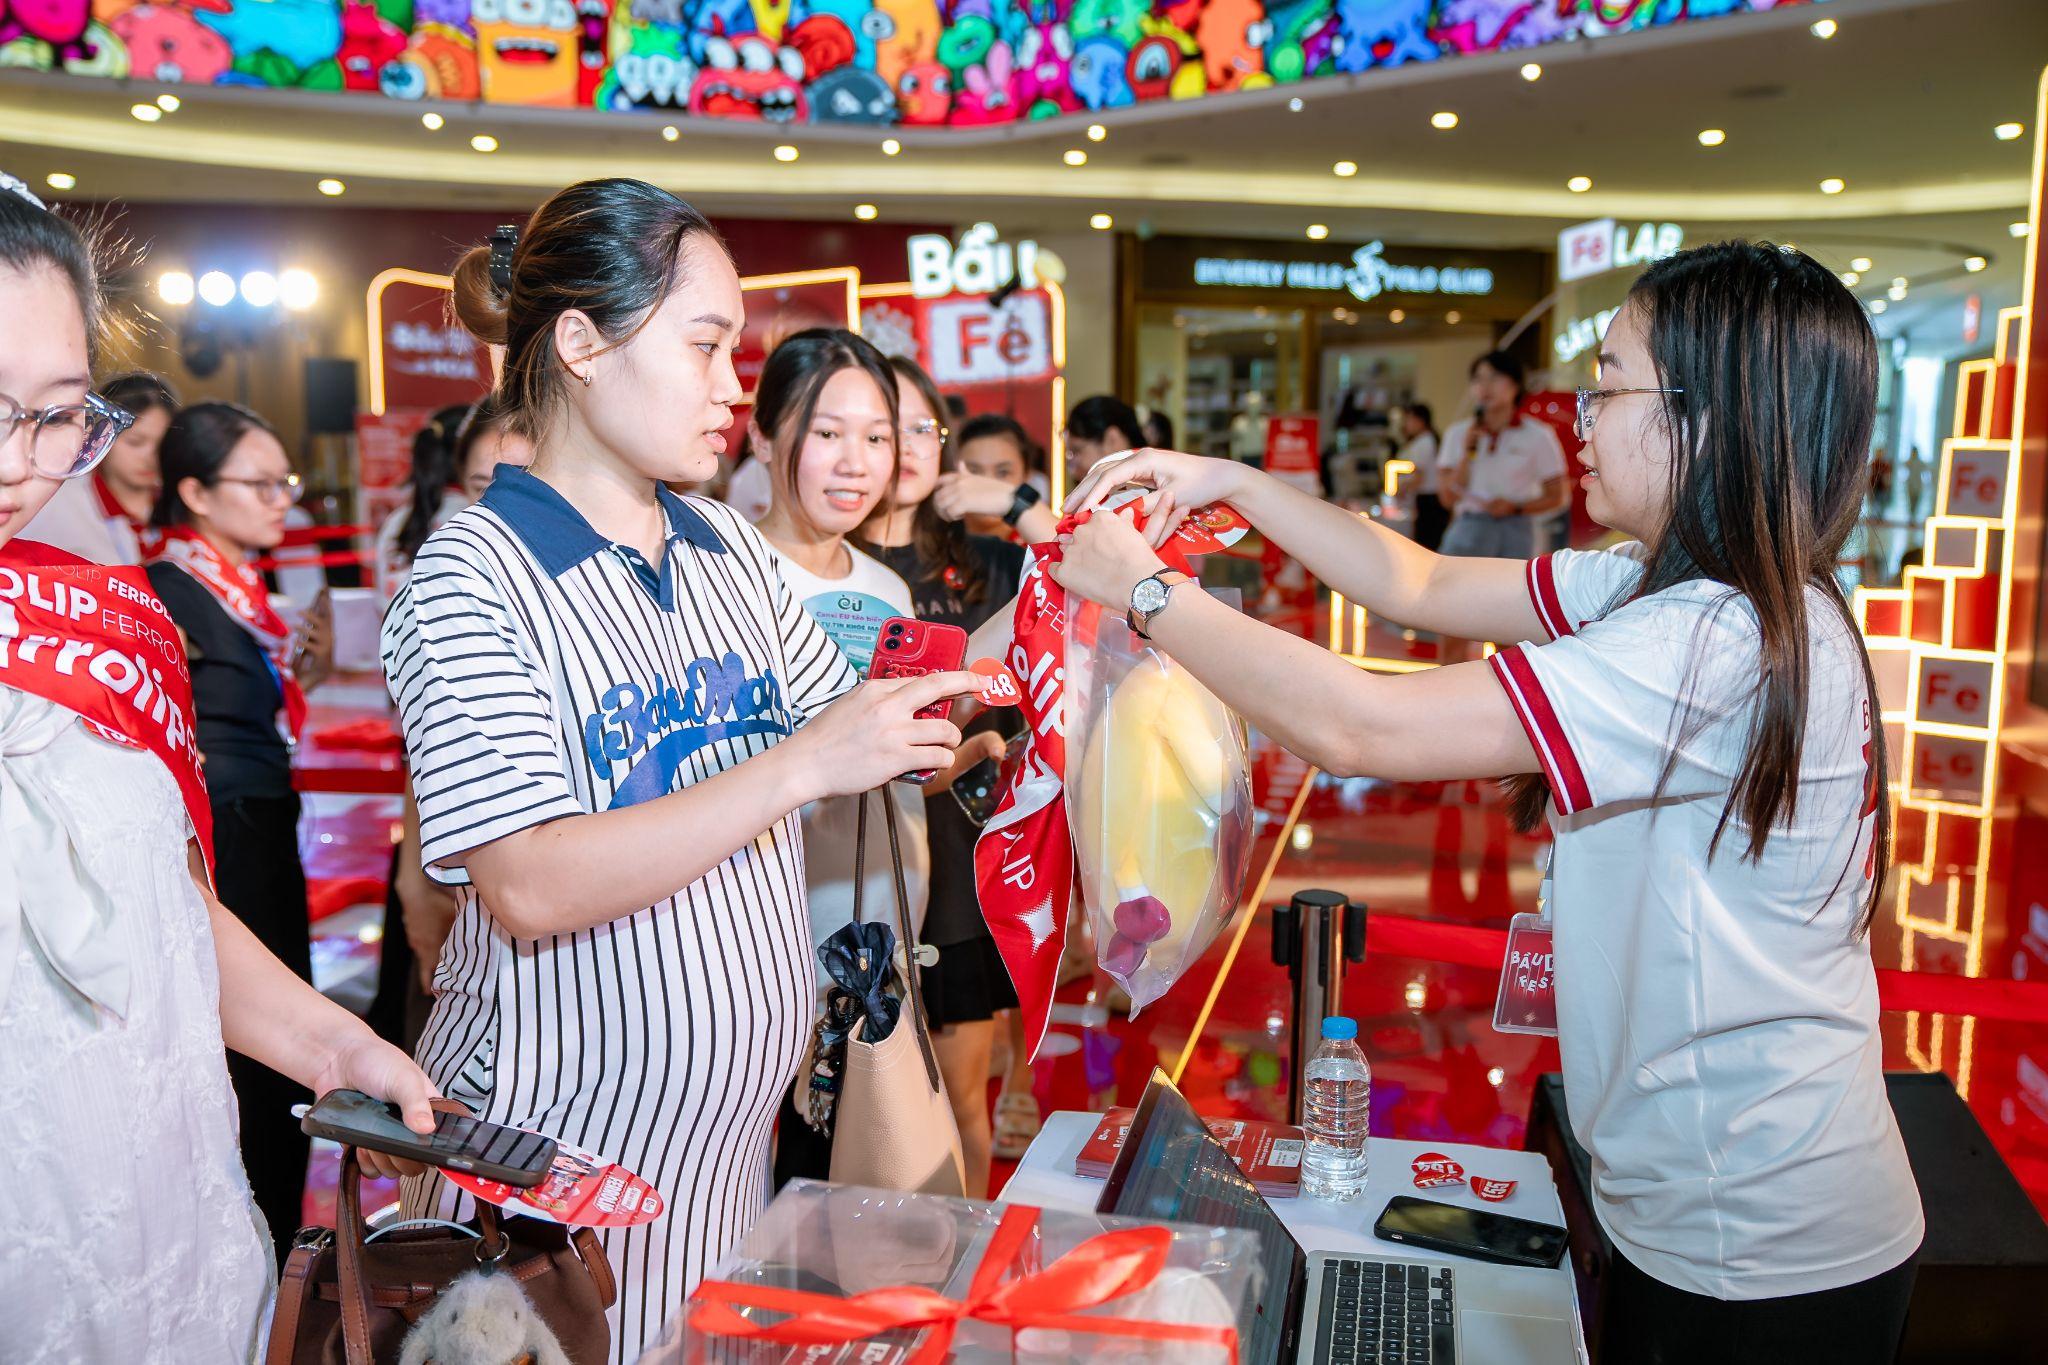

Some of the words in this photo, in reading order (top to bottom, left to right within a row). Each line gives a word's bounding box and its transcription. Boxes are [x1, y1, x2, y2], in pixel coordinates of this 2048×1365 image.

[1613, 222, 1683, 267] LAB
[1953, 464, 1998, 502] Fe
[1925, 673, 1980, 713] Fe
[1518, 974, 1554, 992] FES
